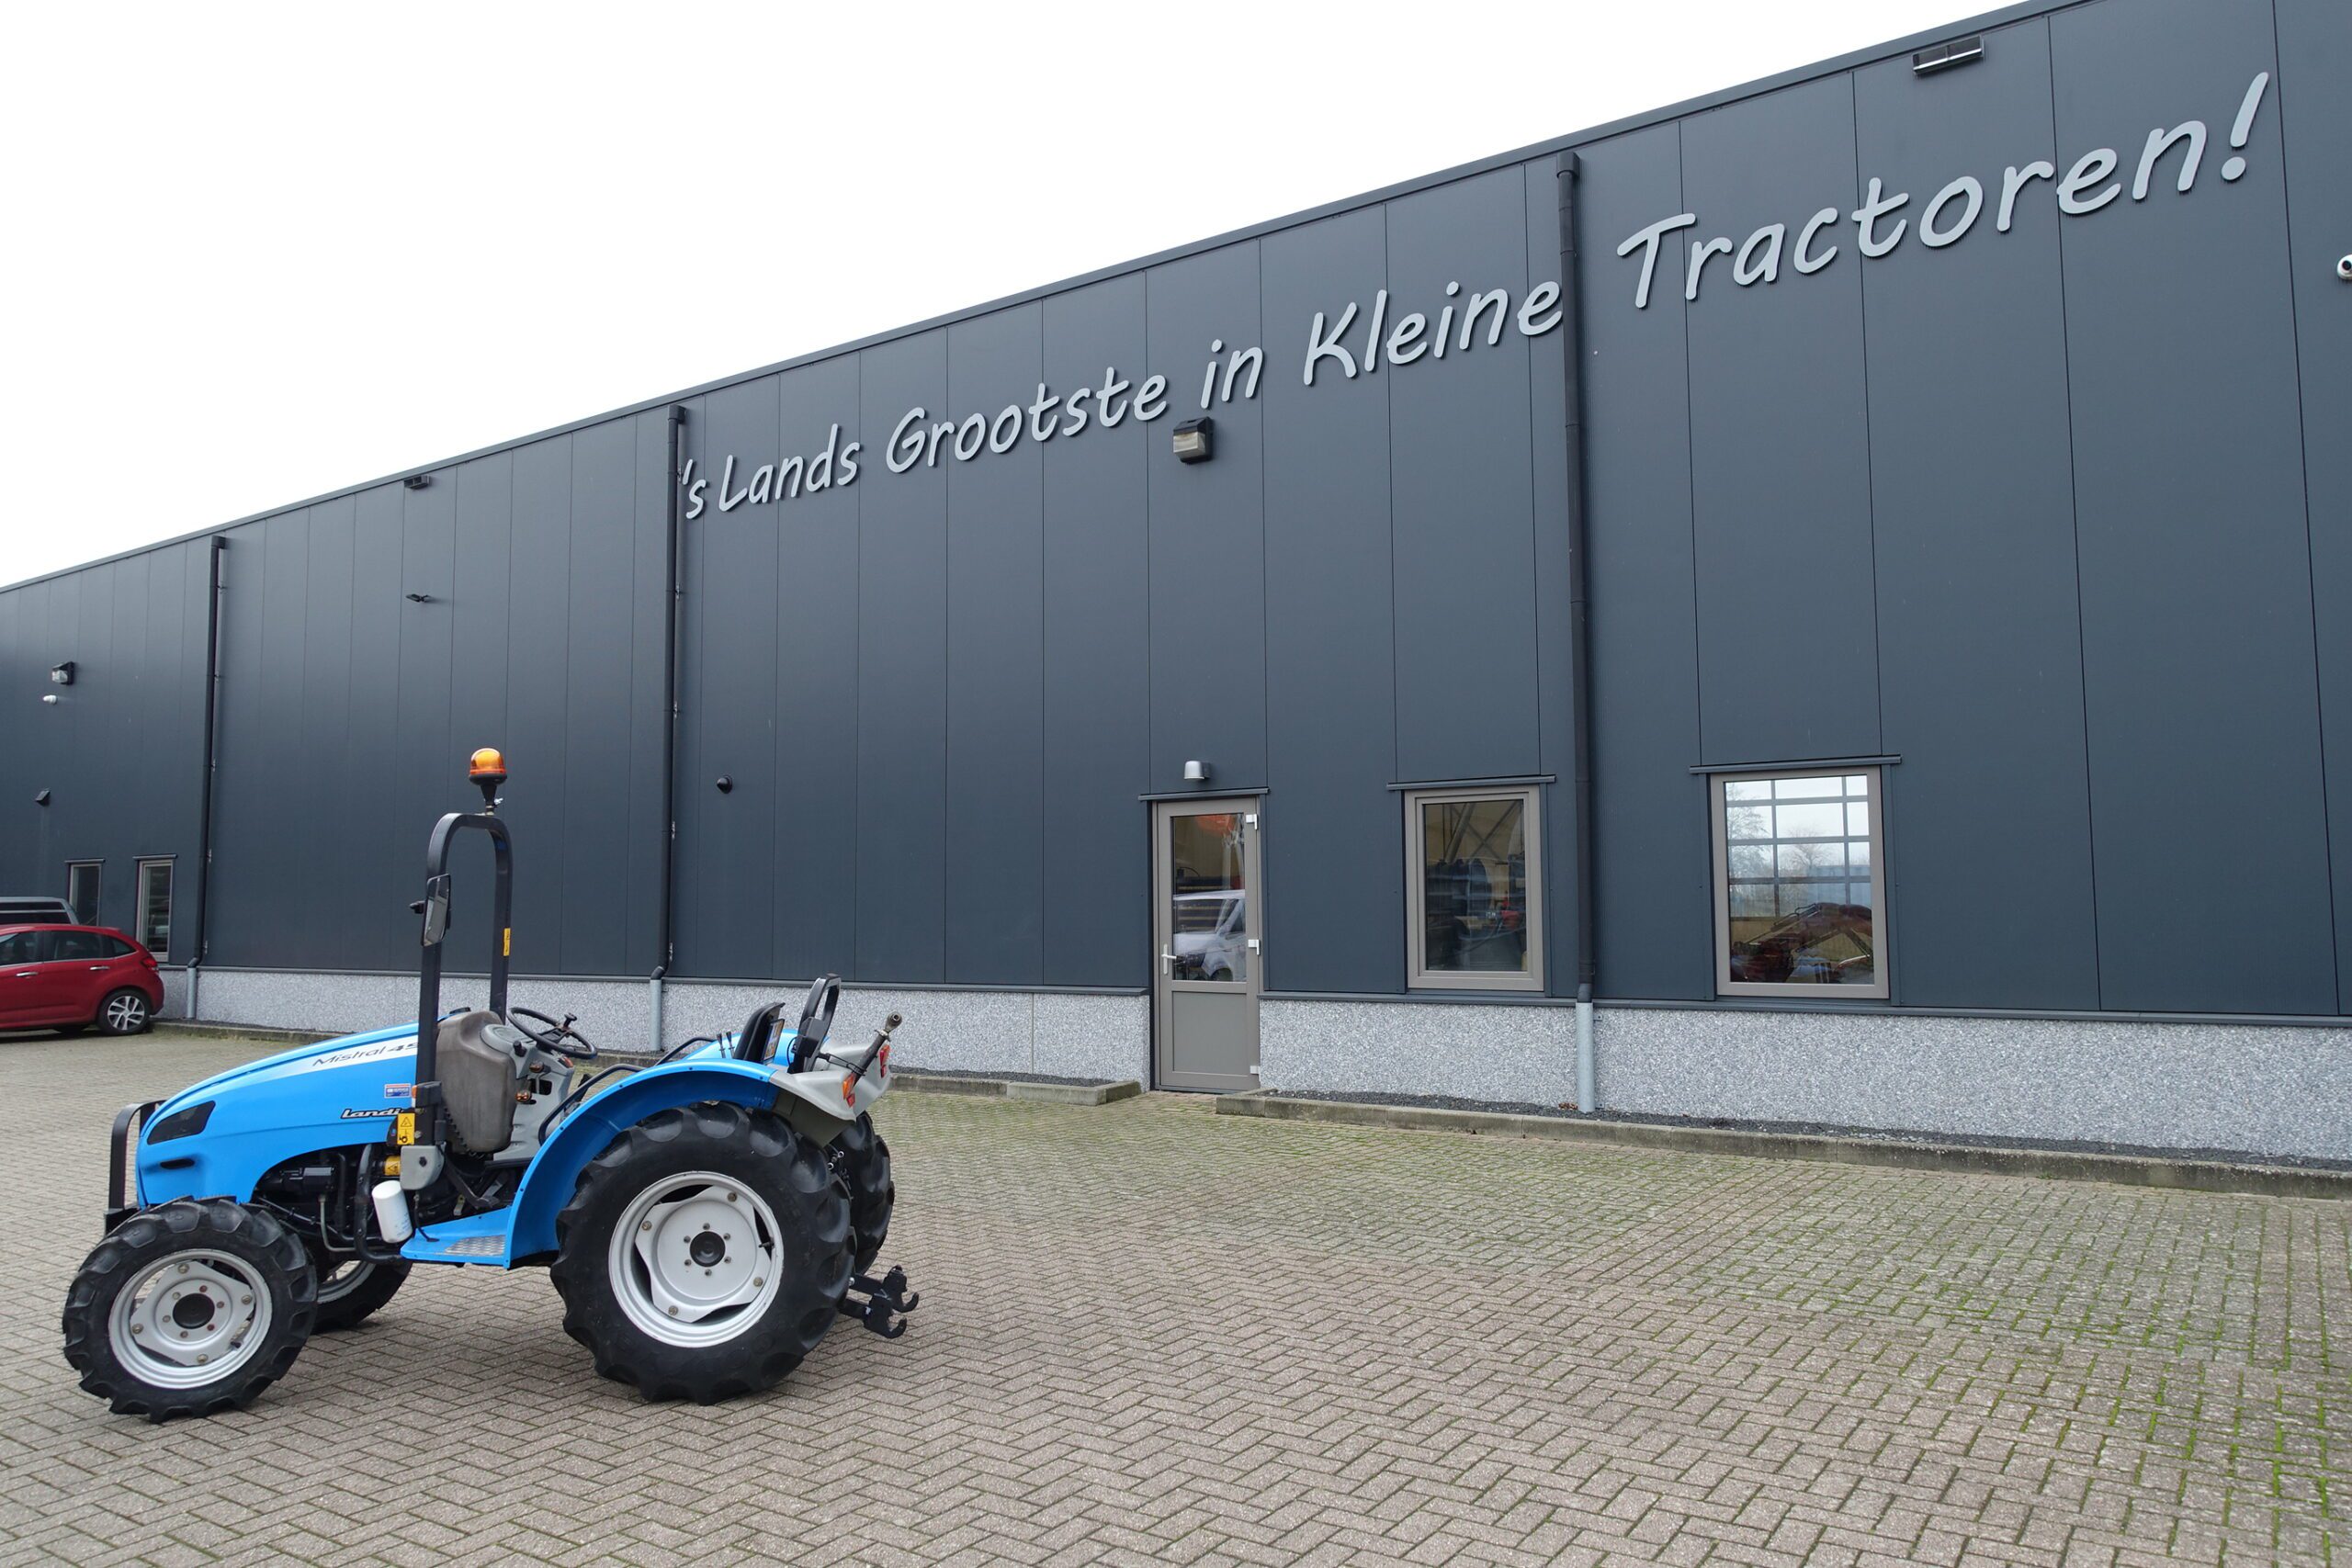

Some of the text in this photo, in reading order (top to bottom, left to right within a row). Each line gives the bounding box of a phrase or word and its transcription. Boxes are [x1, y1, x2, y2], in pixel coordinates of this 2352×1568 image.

[682, 71, 2269, 520] 's Lands Grootste in Kleine Tractoren!
[312, 1046, 387, 1066] Mistral
[340, 1108, 404, 1119] Landi
